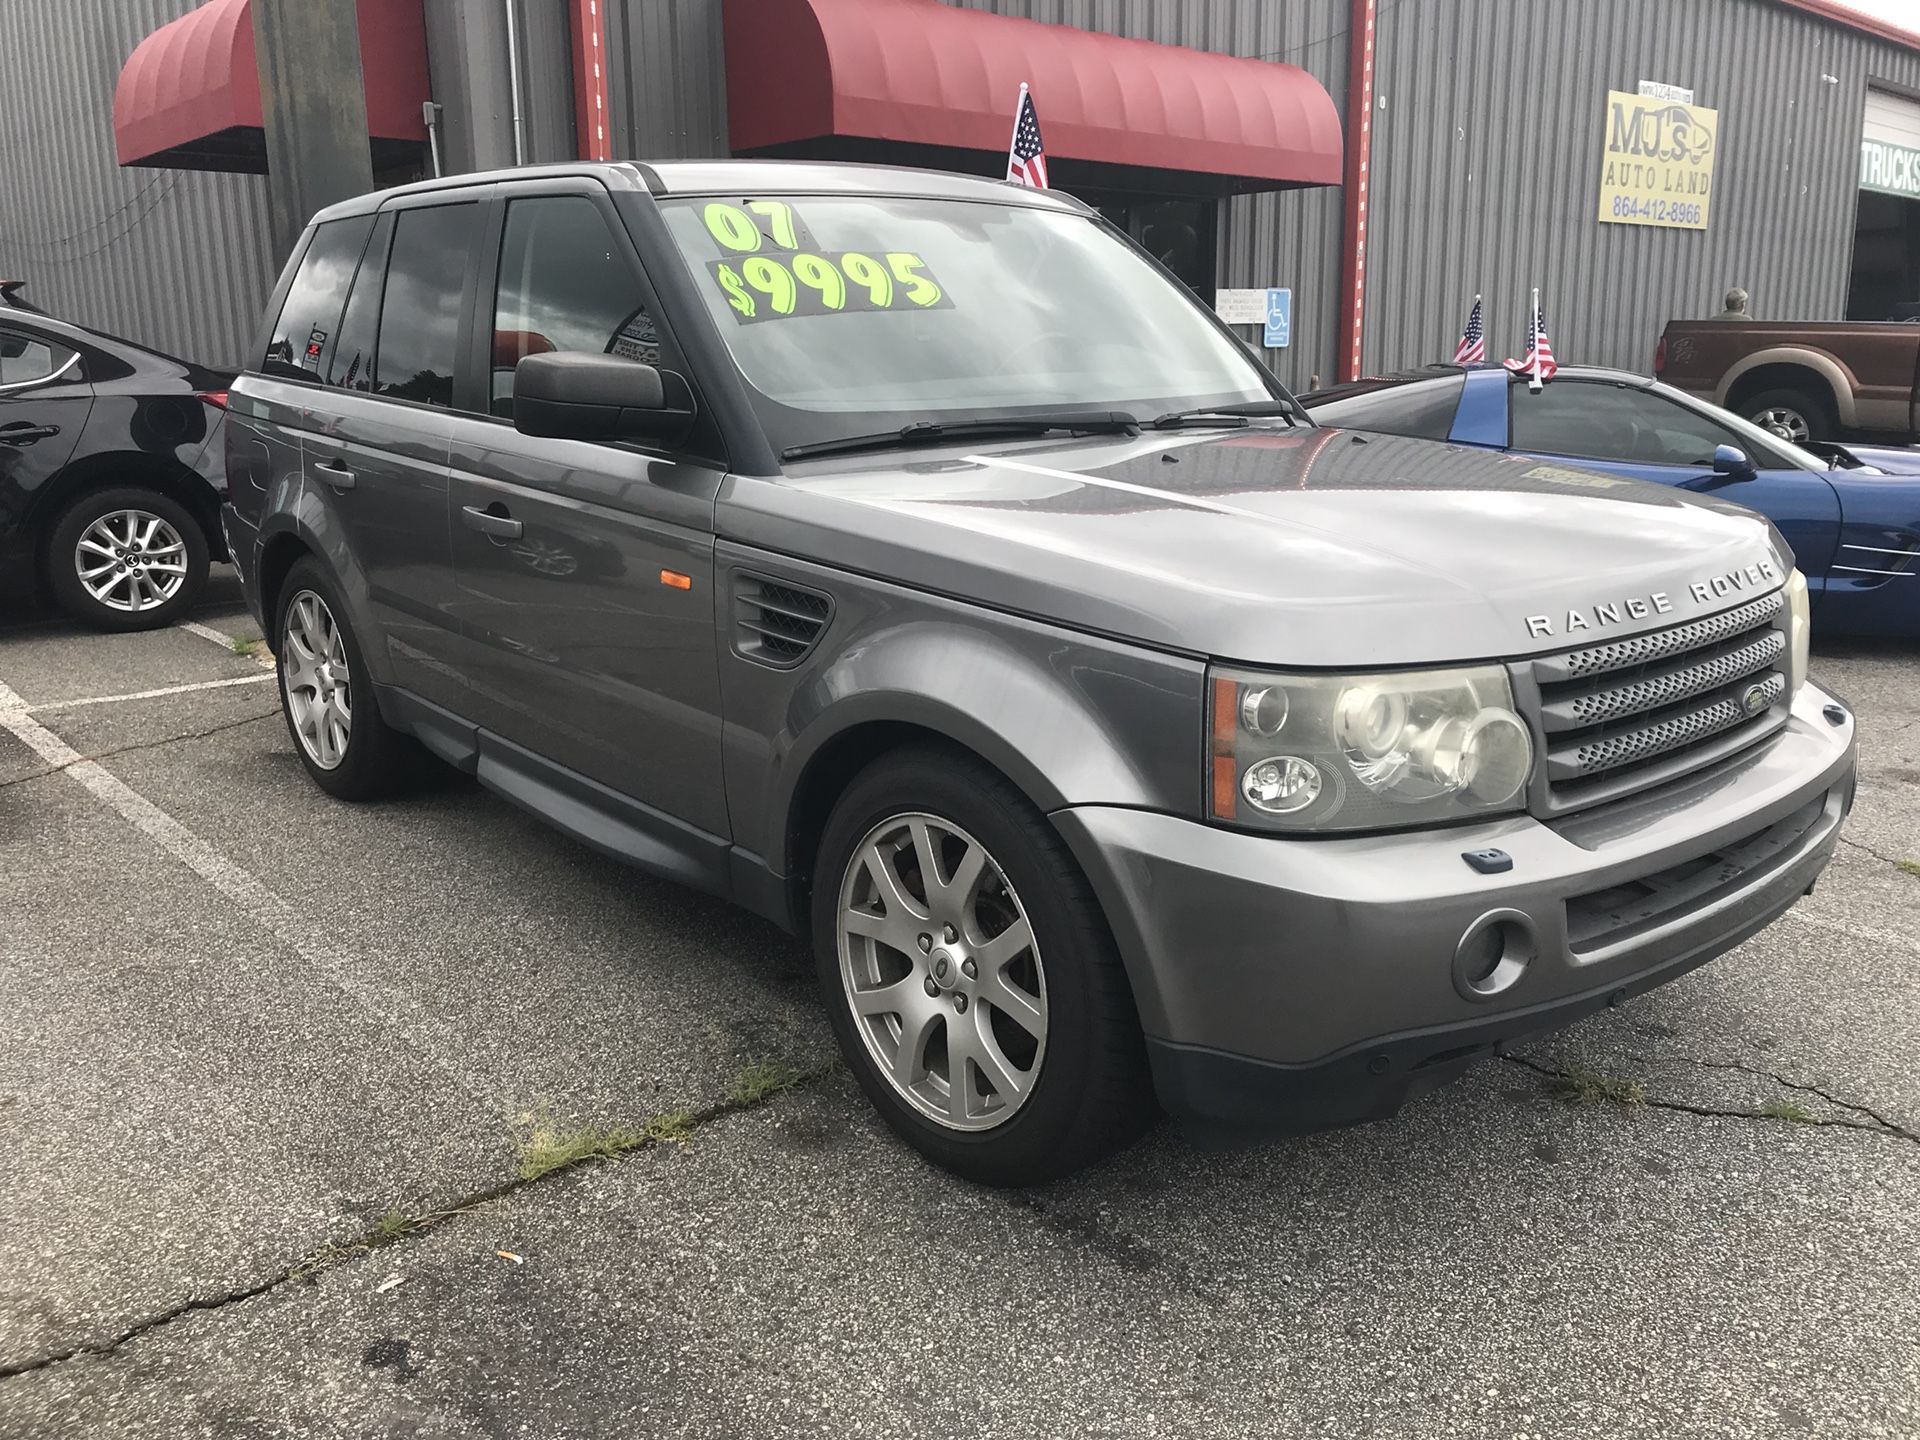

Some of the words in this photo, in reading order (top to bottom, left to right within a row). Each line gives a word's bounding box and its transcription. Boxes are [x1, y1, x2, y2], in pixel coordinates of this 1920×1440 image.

[1605, 161, 1656, 190] AUTO
[1664, 168, 1709, 195] LAND
[1862, 141, 1920, 193] TRUCKS
[704, 201, 799, 252] 07
[1612, 195, 1702, 225] 864-412-8966
[718, 252, 942, 318] $9995
[1525, 592, 1673, 639] RANGE
[1690, 560, 1775, 604] ROVER
